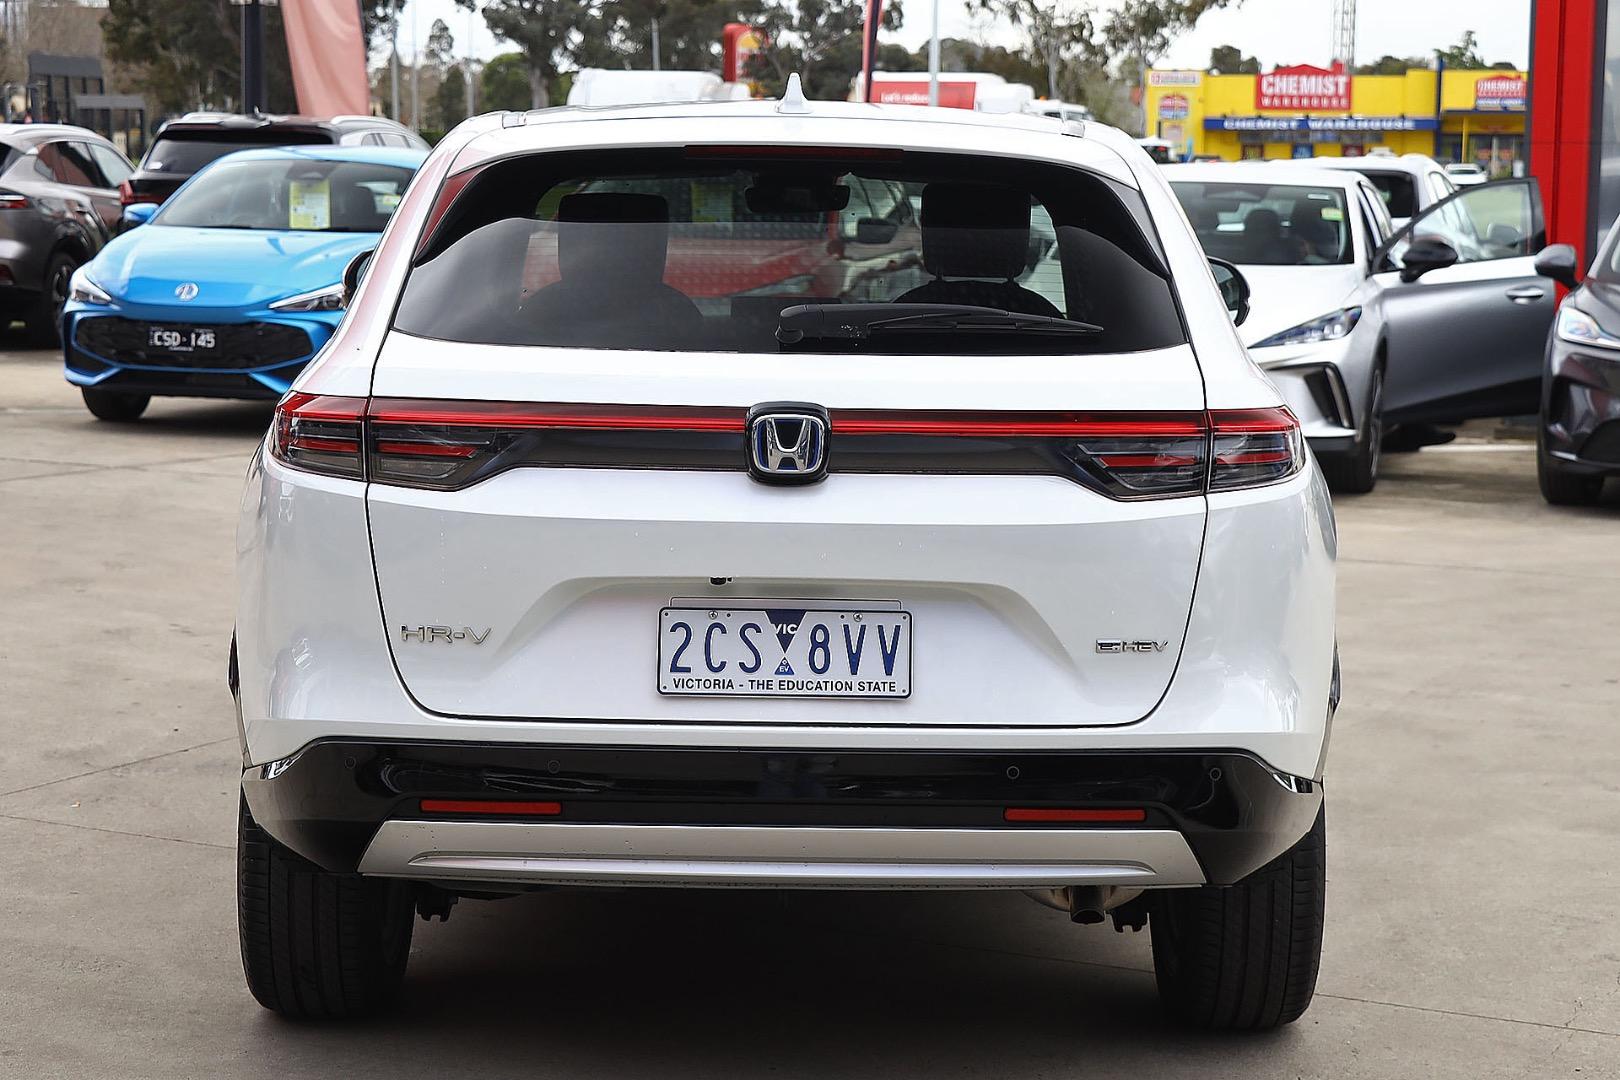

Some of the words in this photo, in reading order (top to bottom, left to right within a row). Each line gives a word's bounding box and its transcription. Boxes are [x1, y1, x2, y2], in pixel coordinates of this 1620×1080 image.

[1261, 74, 1347, 96] CHEMIST
[1223, 118, 1299, 130] CHEMIST
[1307, 119, 1415, 130] WAREHOUSE
[400, 624, 492, 645] HR-V
[772, 623, 798, 635] VIC
[669, 621, 763, 674] 2CS
[808, 623, 901, 677] 8VV
[779, 665, 790, 673] EV
[672, 678, 735, 690] VICTORIA
[748, 679, 774, 691] THE
[778, 680, 853, 692] EDUCATION
[857, 681, 897, 693] STATE
